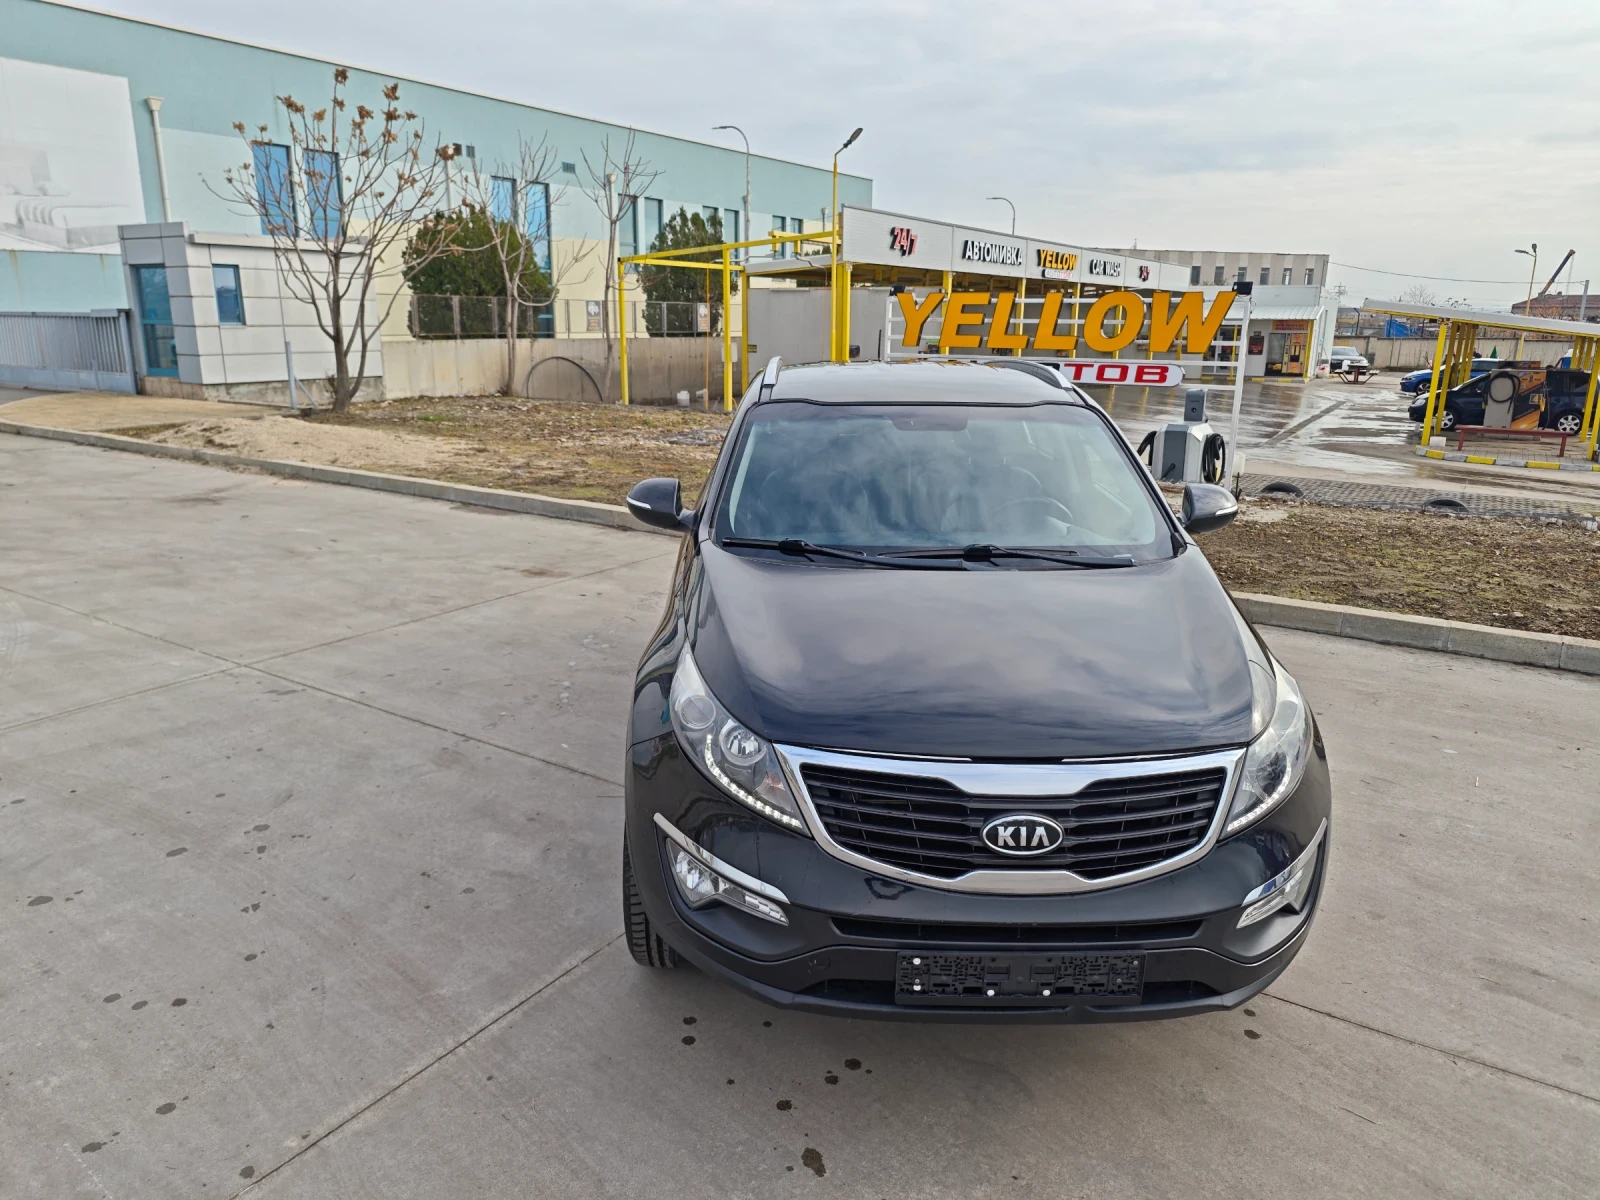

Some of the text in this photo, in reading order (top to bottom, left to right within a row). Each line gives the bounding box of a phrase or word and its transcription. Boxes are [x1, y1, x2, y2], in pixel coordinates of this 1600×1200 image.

[892, 226, 918, 256] 24/7
[964, 240, 1023, 265] АВТОМИВКА
[1038, 249, 1079, 270] YELLOW
[1091, 259, 1121, 277] CAR WASH
[896, 291, 1238, 353] YELLOW
[996, 826, 1050, 847] KIA
